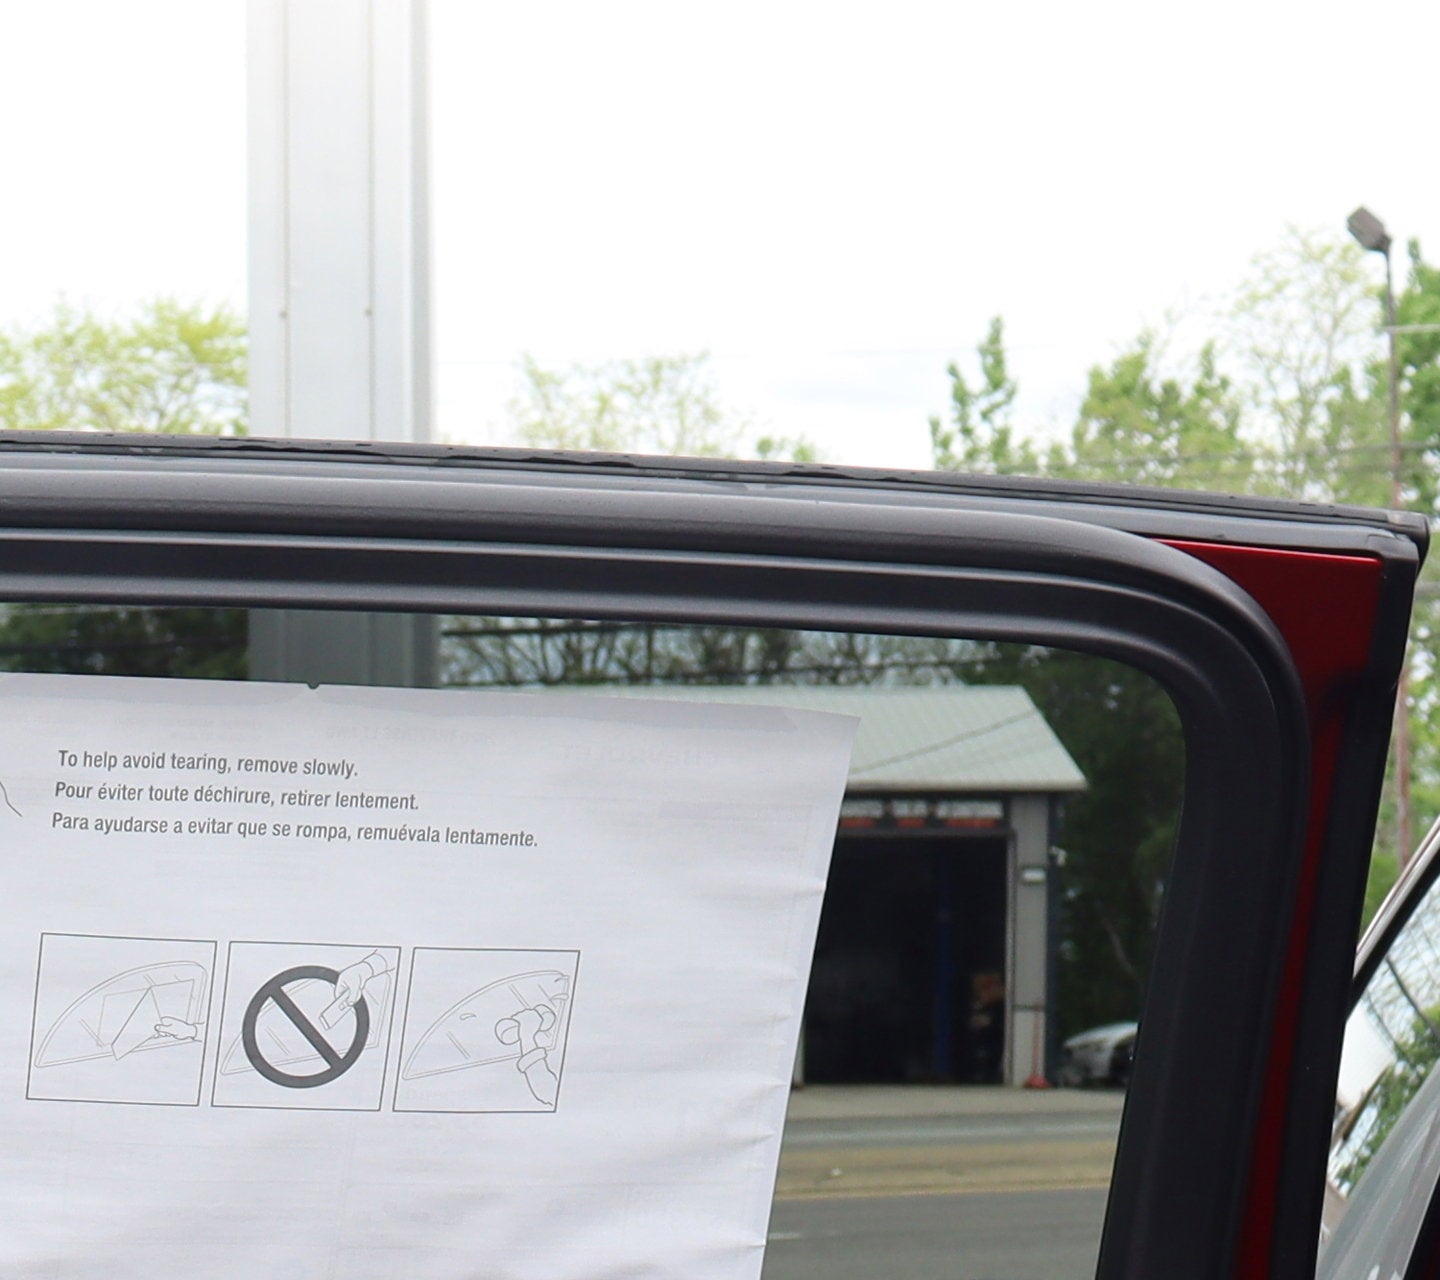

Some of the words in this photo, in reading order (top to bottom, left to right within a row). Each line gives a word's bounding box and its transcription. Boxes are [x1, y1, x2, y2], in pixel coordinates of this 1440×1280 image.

[58, 749, 78, 768] To
[82, 750, 118, 770] help
[122, 751, 166, 770] avoid
[170, 752, 232, 775] tearing,
[237, 758, 298, 775] remove
[302, 758, 358, 780] slowly.
[54, 781, 94, 799] Pour
[97, 782, 145, 801] éviter
[148, 784, 189, 802] toute
[193, 784, 275, 808] déchirure,
[280, 789, 332, 807] retirer
[335, 791, 419, 811] lentement.
[51, 811, 90, 831] Para
[94, 816, 169, 836] ayudarse
[173, 820, 183, 834] a
[187, 818, 234, 835] evitar
[237, 821, 268, 839] que
[271, 823, 291, 837] se
[295, 824, 352, 843] rompa,
[357, 823, 441, 843] remuévala
[445, 826, 538, 848] lentamente.
